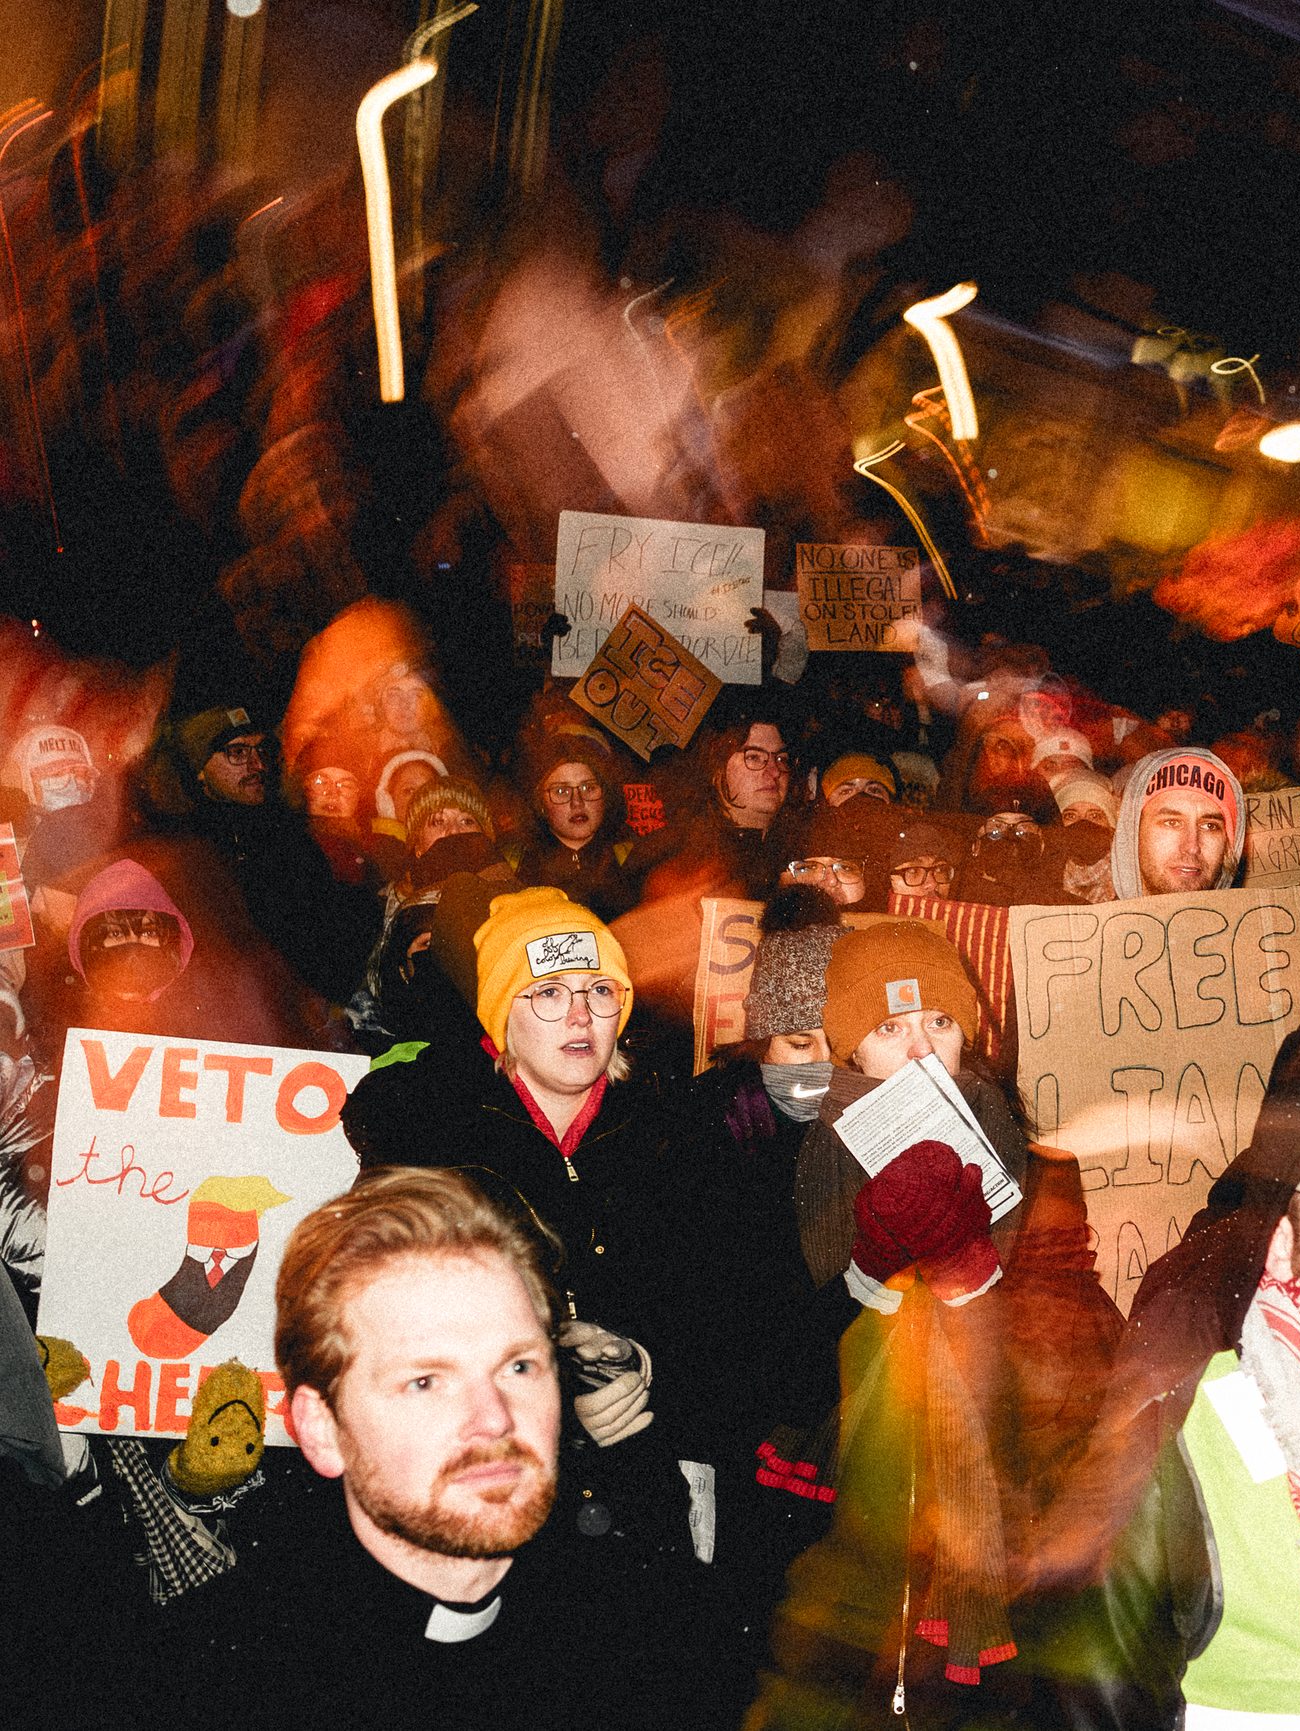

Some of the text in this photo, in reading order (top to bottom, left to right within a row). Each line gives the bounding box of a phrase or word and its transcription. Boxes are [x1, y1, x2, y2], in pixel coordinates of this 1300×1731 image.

[571, 525, 746, 579] FRY ICE!!
[800, 545, 835, 570] NO
[840, 547, 893, 570] ONE
[563, 591, 594, 622] NO
[809, 575, 915, 602] ILLEGAL
[804, 602, 837, 622] ON
[826, 622, 898, 645] LAND
[603, 607, 708, 722] ICE
[584, 668, 681, 752] OUT
[38, 737, 66, 754] MELT
[1145, 763, 1226, 802] CHICAGO
[1023, 905, 1296, 1040] FREE
[79, 1038, 349, 1136] VETO
[56, 1135, 190, 1205] the
